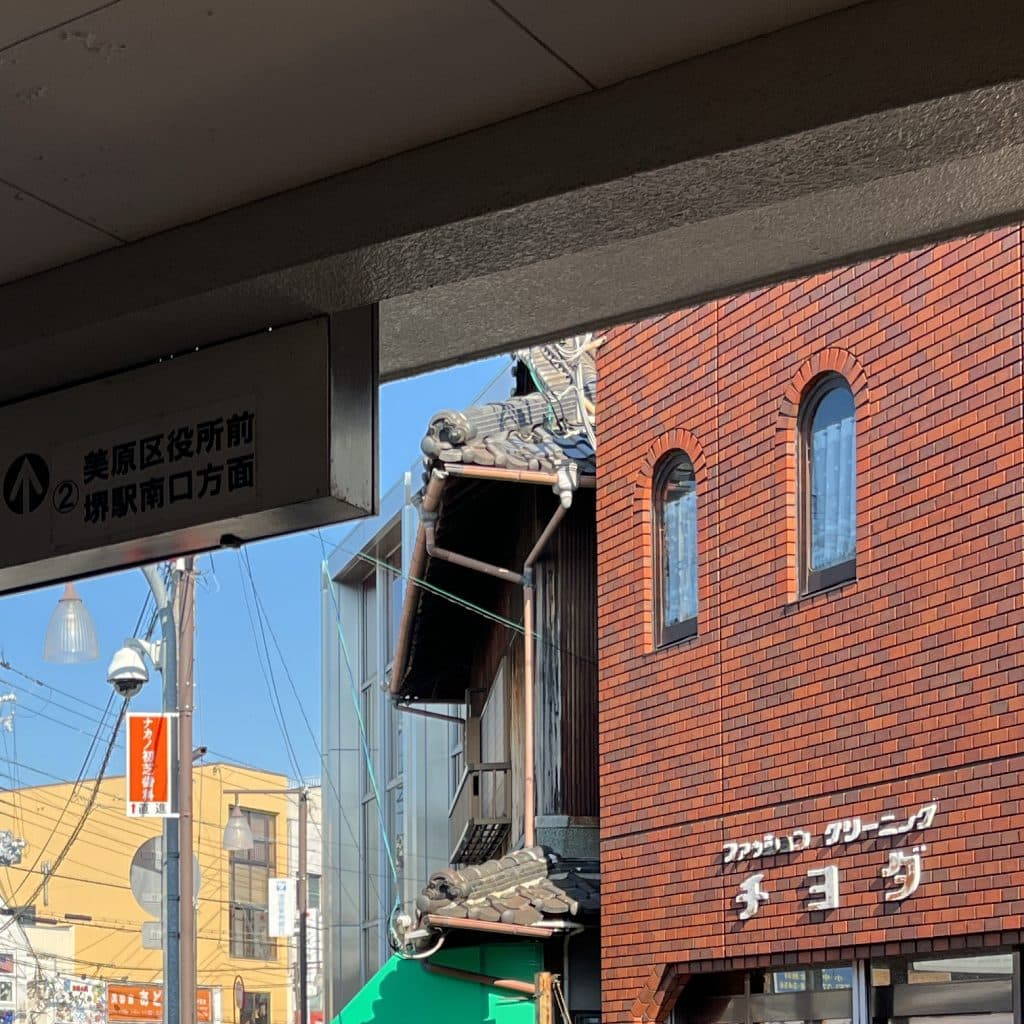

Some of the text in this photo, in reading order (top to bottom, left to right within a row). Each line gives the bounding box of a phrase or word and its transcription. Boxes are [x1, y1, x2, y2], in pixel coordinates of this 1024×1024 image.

[82, 410, 255, 484] 美原区役所前
[82, 453, 255, 524] 堺駅南口方面
